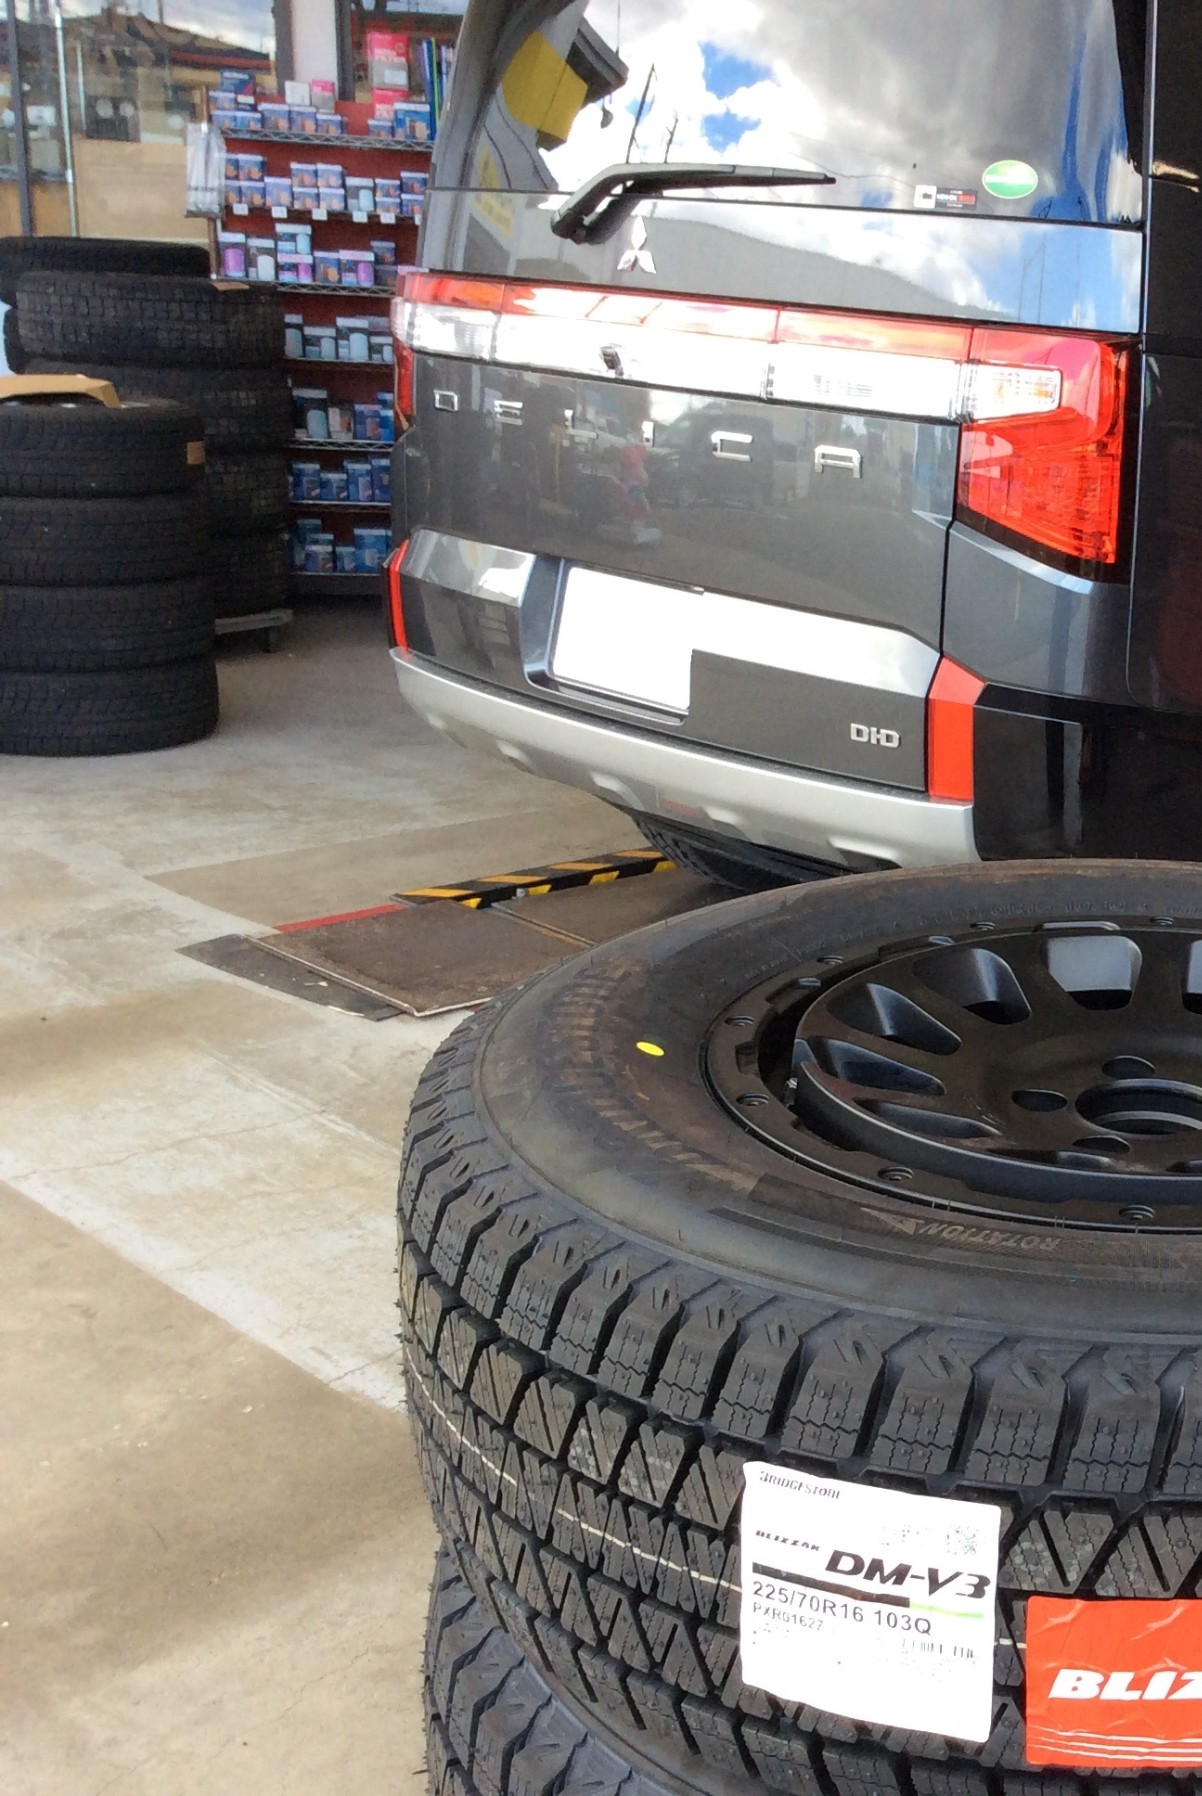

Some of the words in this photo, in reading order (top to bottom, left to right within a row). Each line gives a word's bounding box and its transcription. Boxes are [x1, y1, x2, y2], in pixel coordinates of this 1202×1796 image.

[433, 389, 863, 479] DELICA
[755, 1529, 820, 1552] BLIZZAK
[825, 1549, 991, 1599] DM-V3
[752, 1580, 864, 1623] 225/70R16
[874, 1609, 931, 1636] 103Q
